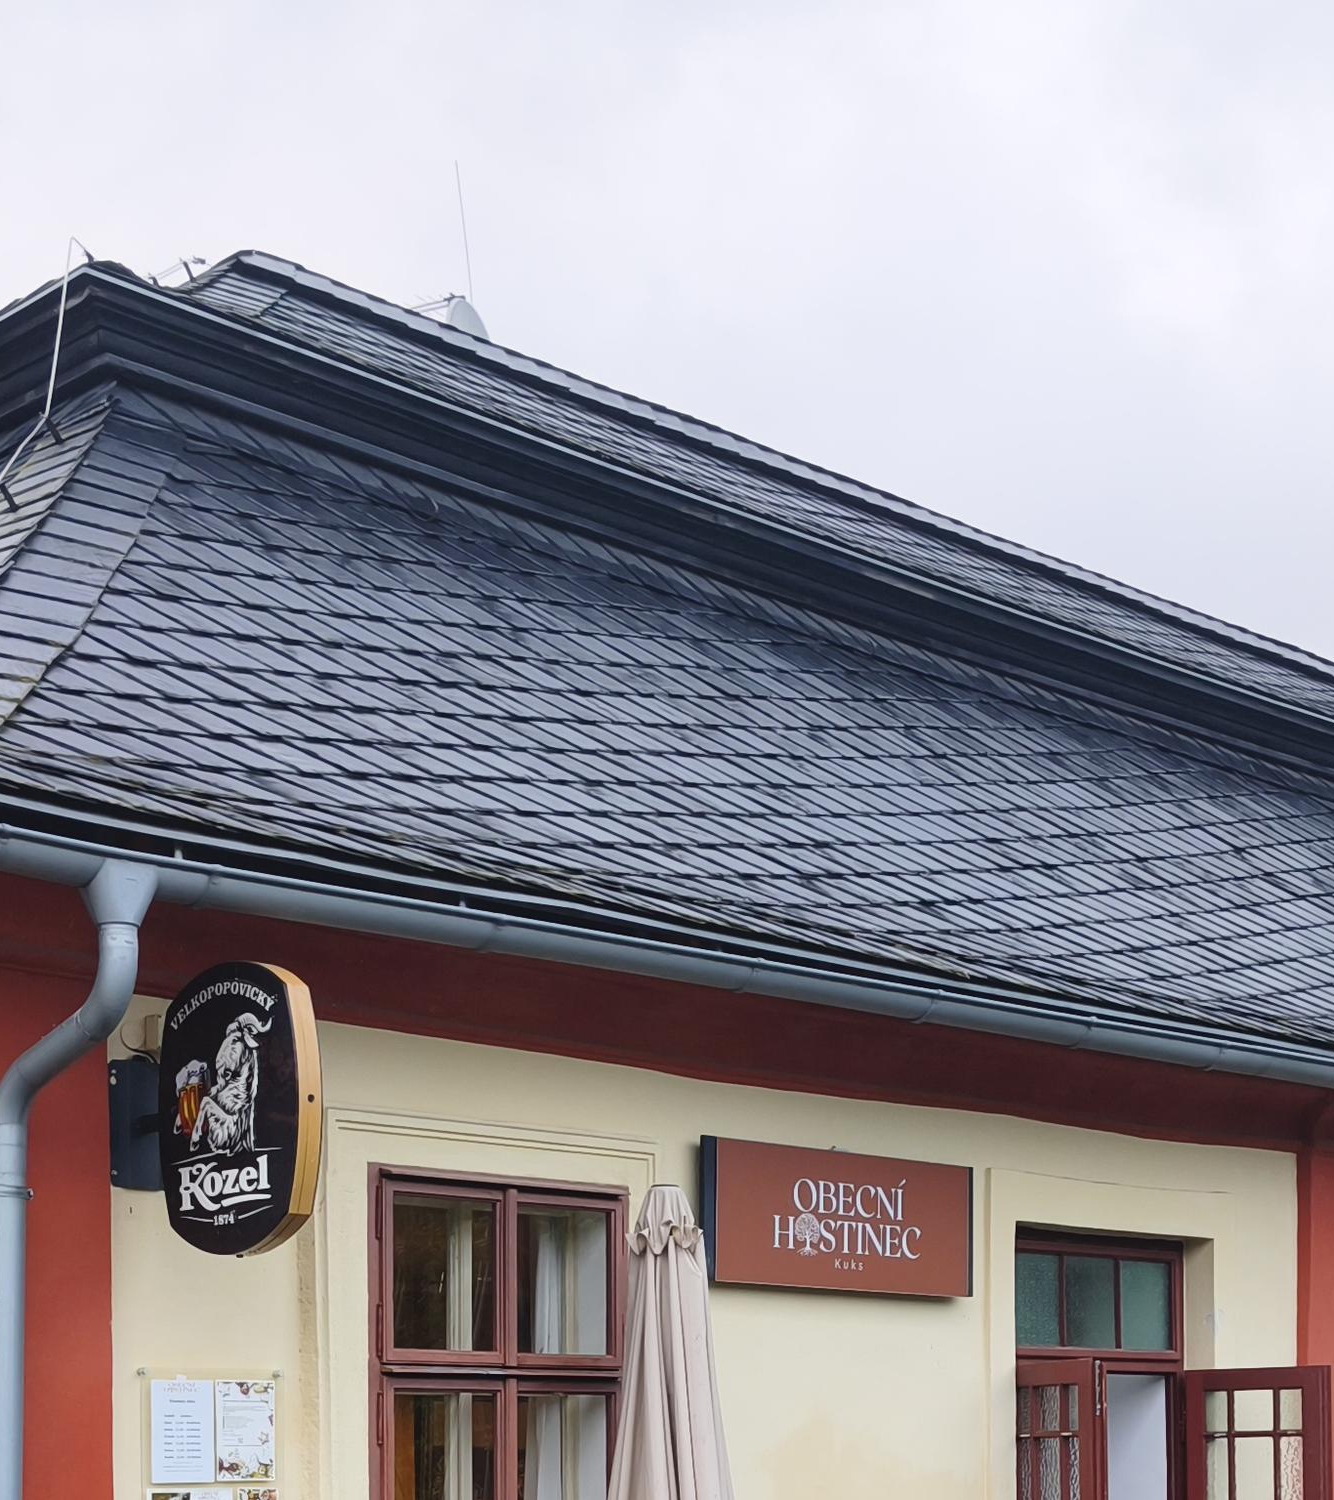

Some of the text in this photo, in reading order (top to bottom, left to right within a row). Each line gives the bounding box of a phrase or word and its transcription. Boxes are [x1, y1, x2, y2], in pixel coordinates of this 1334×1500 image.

[170, 978, 278, 1032] VELKOPOPOVICKÝ
[179, 1154, 272, 1212] Kozel
[793, 1178, 907, 1221] OBECNÍ
[213, 1212, 235, 1226] 1874
[834, 1257, 864, 1271] Kuks
